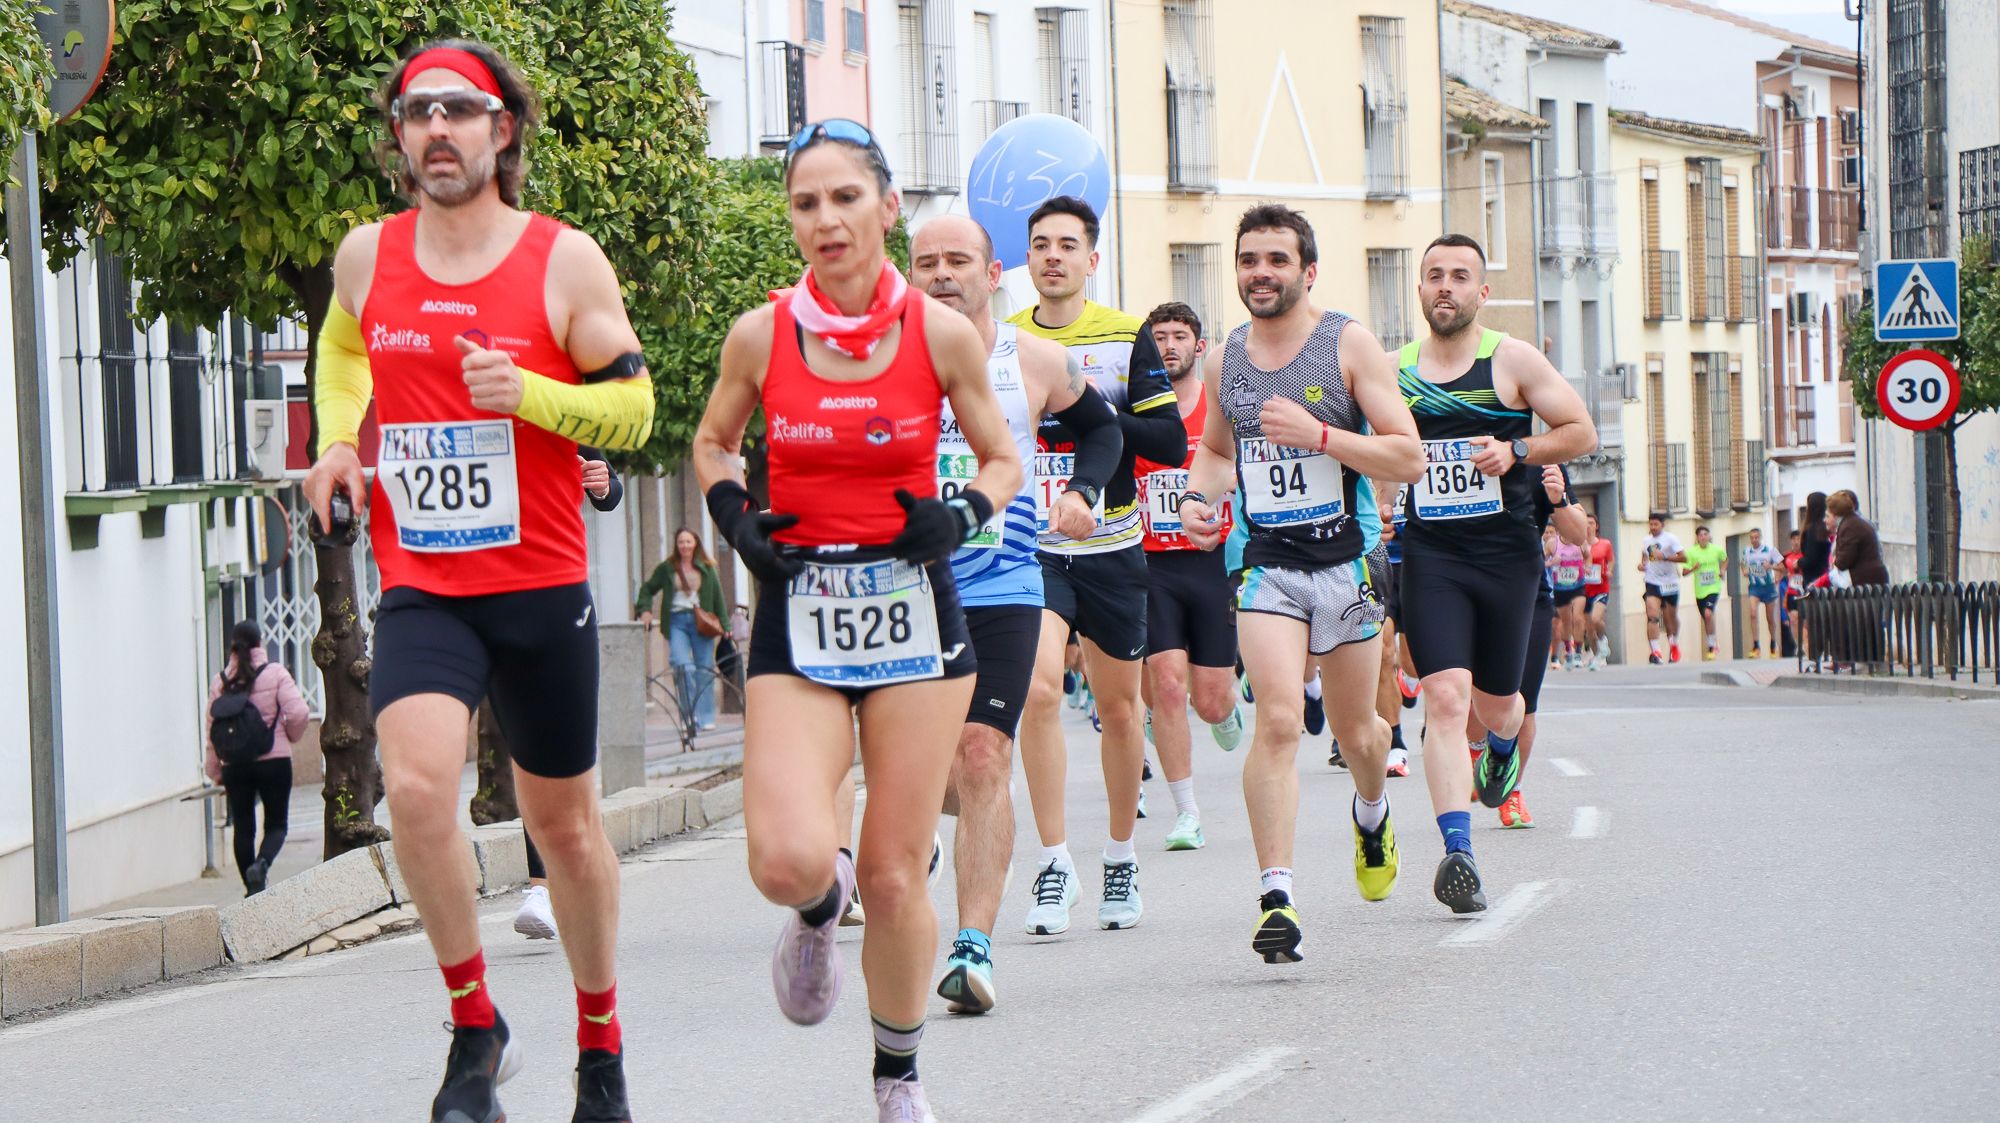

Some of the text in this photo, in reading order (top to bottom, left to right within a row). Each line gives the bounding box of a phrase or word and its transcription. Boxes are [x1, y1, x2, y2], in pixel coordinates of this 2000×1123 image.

[381, 328, 431, 347] califas
[1896, 377, 1942, 404] 30
[394, 428, 432, 459] 21K
[783, 422, 834, 440] califas
[1251, 442, 1281, 463] 21K
[395, 462, 492, 511] 1285
[1269, 462, 1307, 498] 94
[1426, 464, 1485, 495] 1364
[808, 566, 850, 598] 21K
[809, 600, 913, 652] 1528
